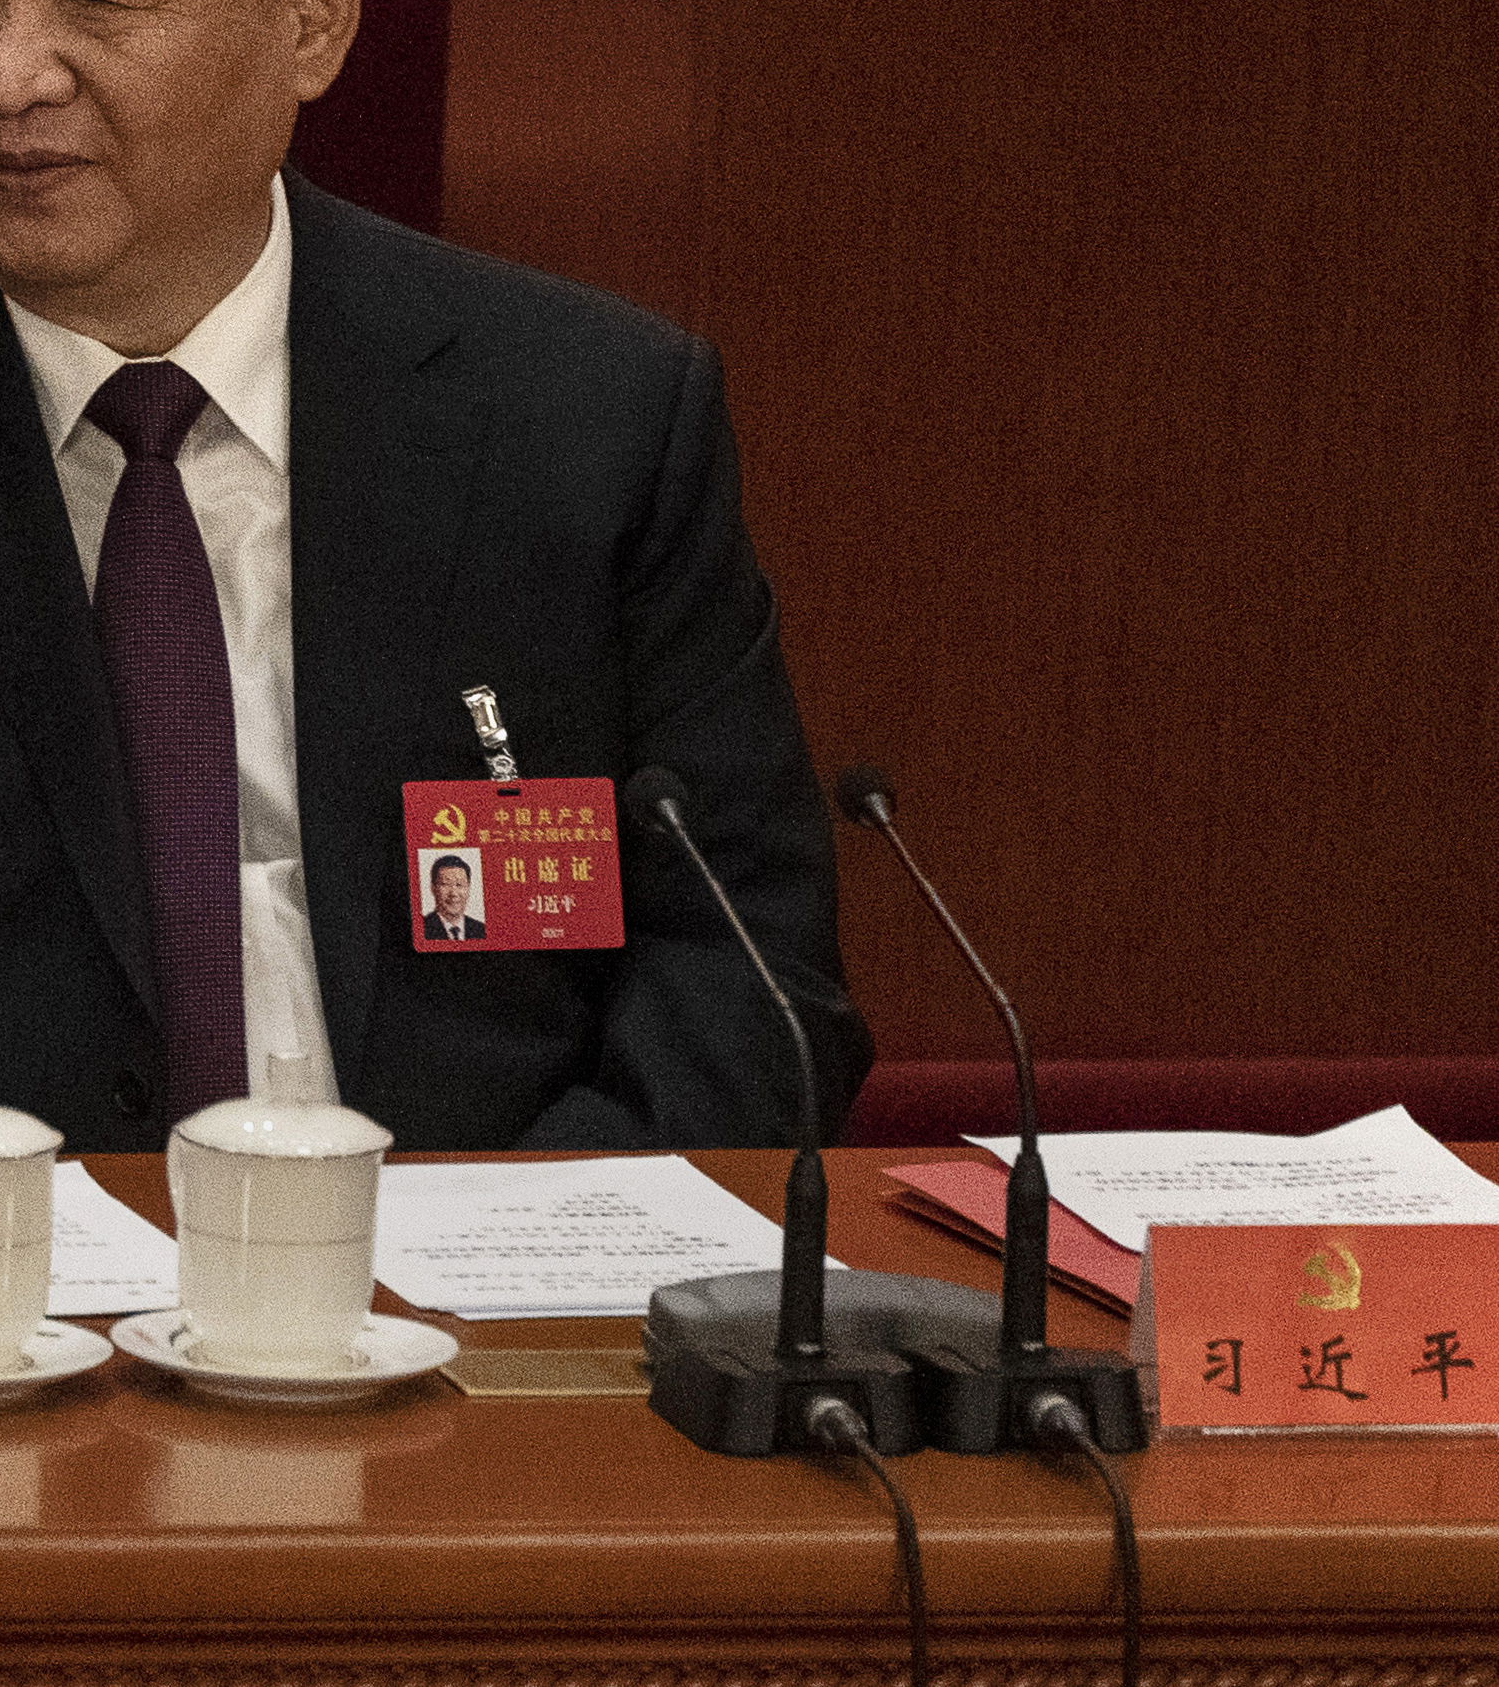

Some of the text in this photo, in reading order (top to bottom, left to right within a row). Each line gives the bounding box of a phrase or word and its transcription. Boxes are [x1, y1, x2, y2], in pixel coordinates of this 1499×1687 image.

[493, 806, 595, 826] 中国共产党
[503, 855, 594, 884] 出席证
[1202, 1329, 1476, 1401] 习近平
